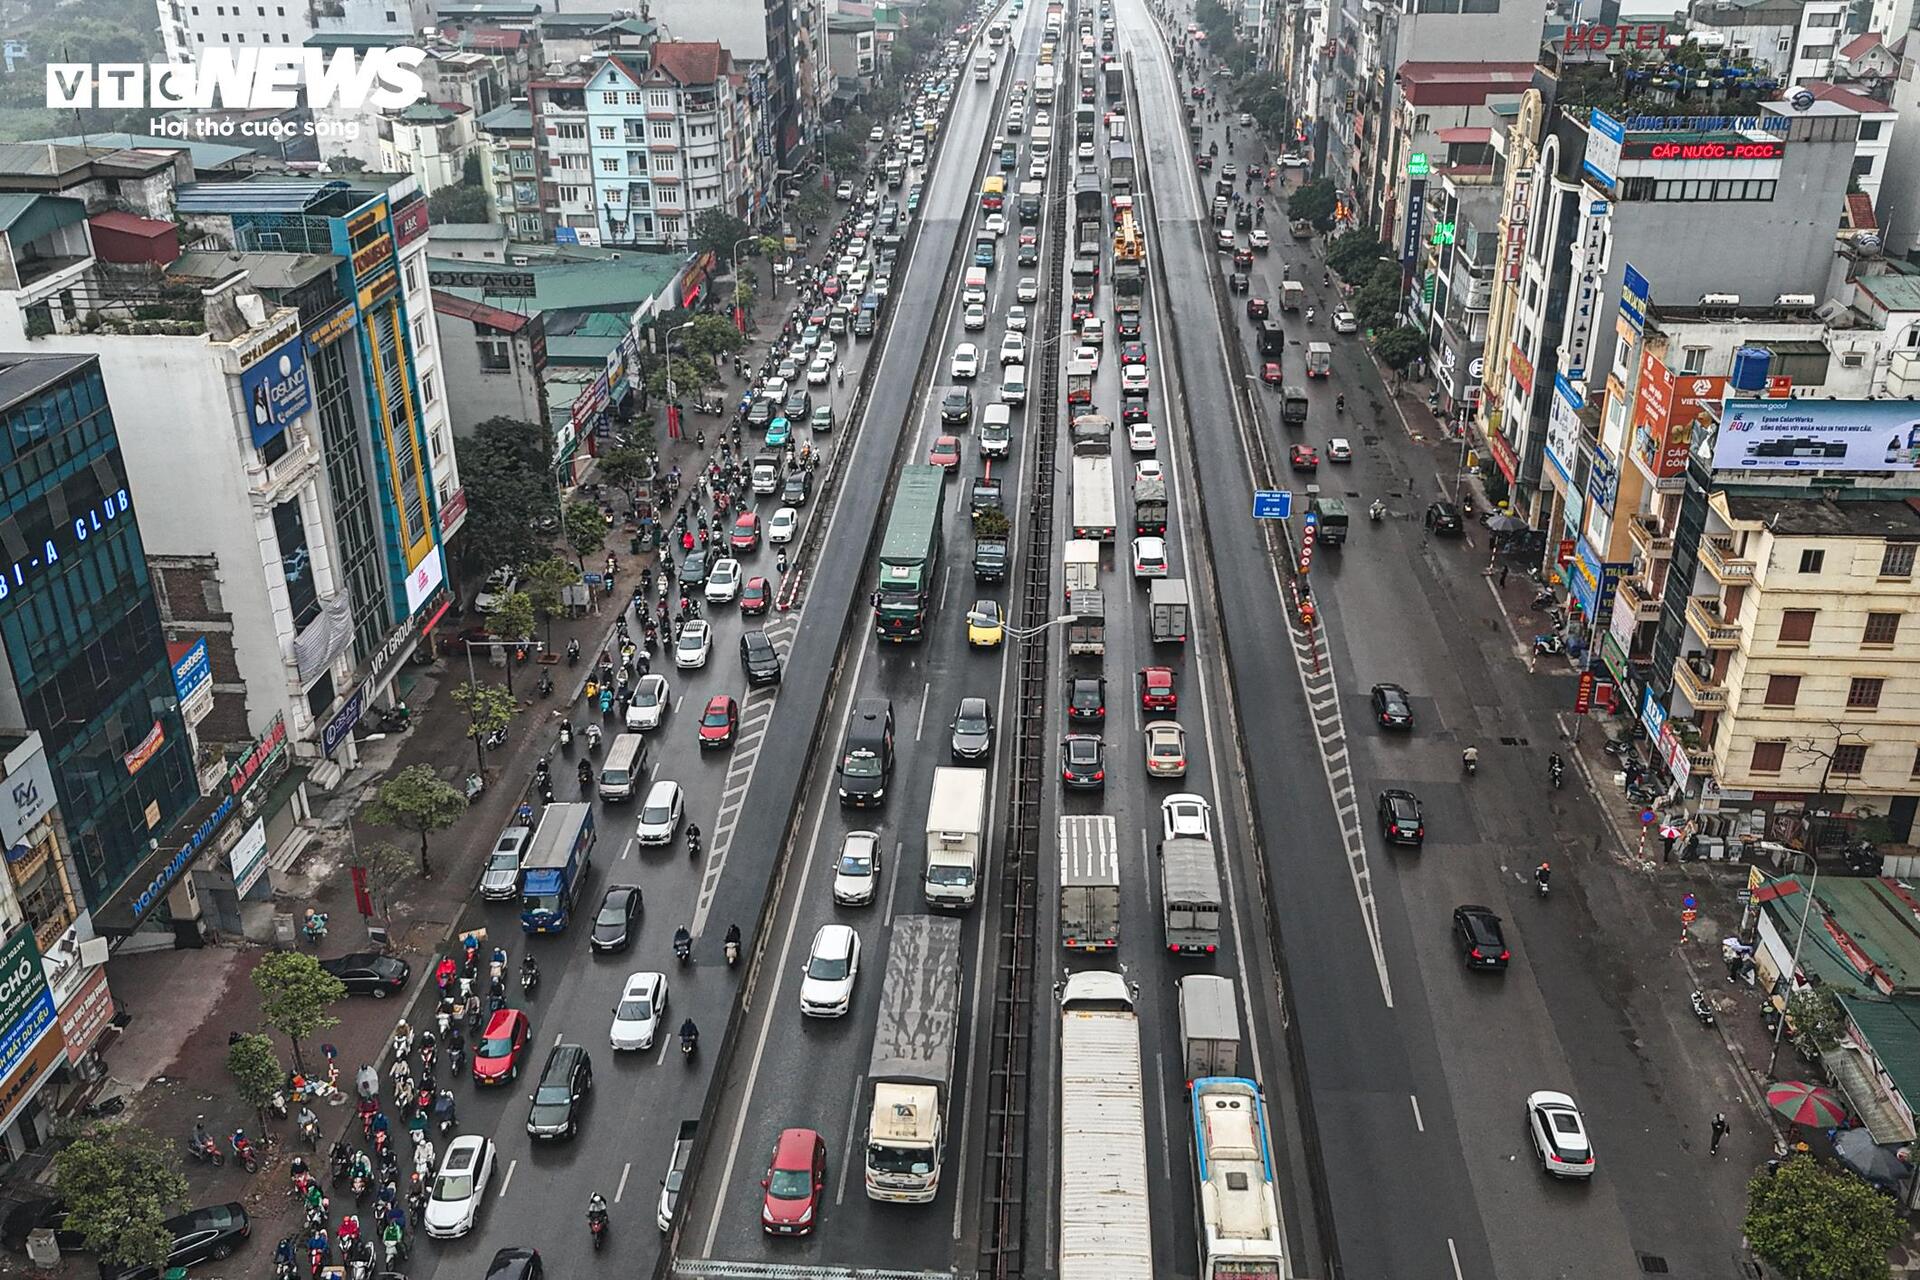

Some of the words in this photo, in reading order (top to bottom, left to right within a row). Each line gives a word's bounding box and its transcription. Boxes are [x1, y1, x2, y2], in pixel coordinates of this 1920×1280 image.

[1564, 25, 1677, 50] HOTEL
[1735, 144, 1773, 158] PCCC
[1505, 184, 1529, 281] HOTEL
[1768, 401, 1788, 411] good
[75, 489, 129, 541] CLUB
[177, 643, 205, 680] seebest
[371, 648, 390, 676] VPT
[388, 615, 416, 656] GROUP
[191, 795, 234, 849] BUILDING
[0, 957, 31, 1003] CHÓ
